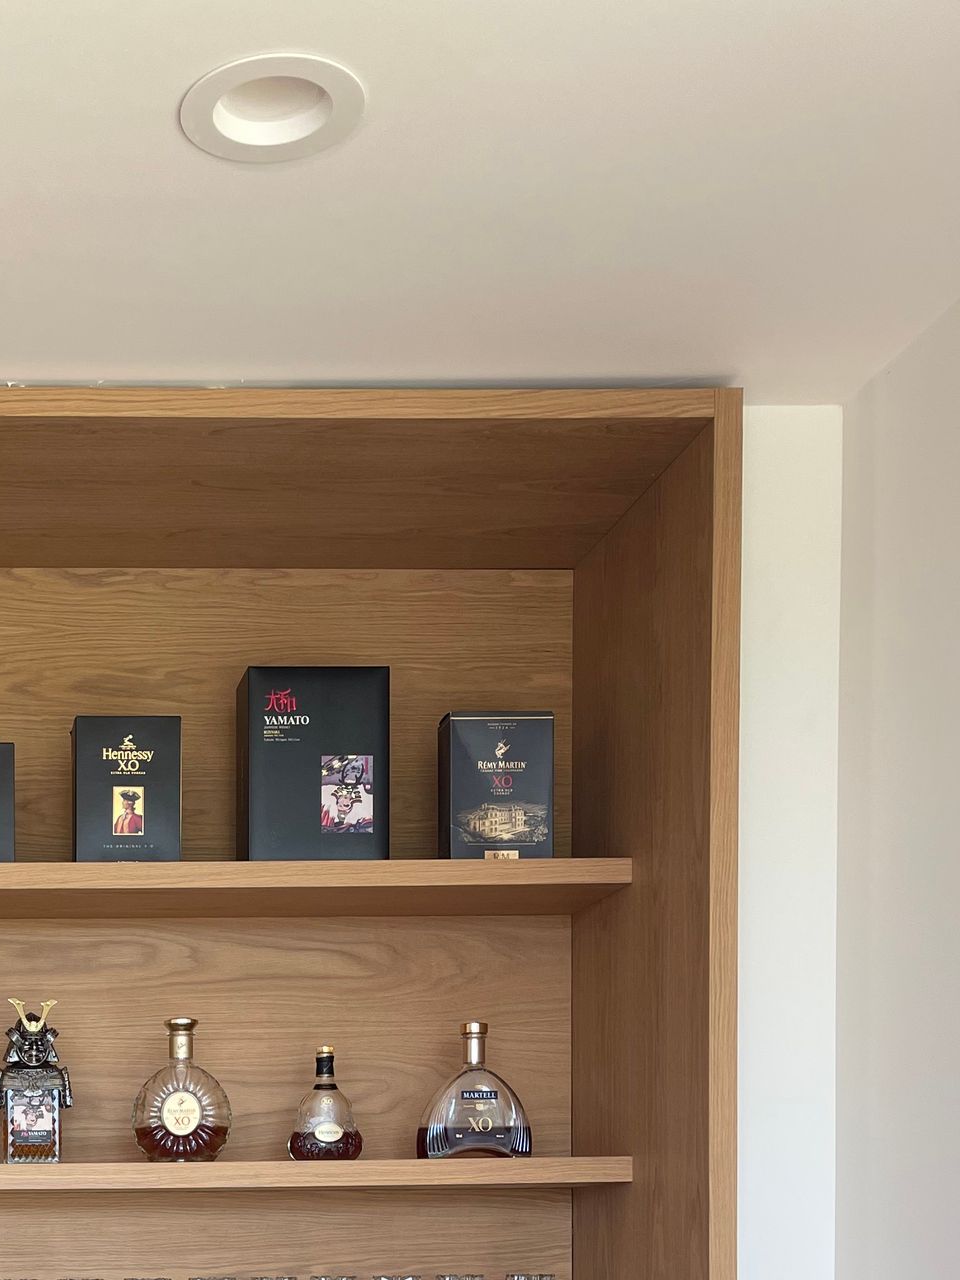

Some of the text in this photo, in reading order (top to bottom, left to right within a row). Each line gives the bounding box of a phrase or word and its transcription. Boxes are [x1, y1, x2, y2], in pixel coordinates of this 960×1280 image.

[263, 715, 310, 725] YAMATO
[102, 747, 155, 762] Hennessy
[498, 760, 526, 769] MARTIN
[492, 774, 513, 788] XO
[174, 1116, 191, 1126] XO
[468, 1116, 493, 1132] XO
